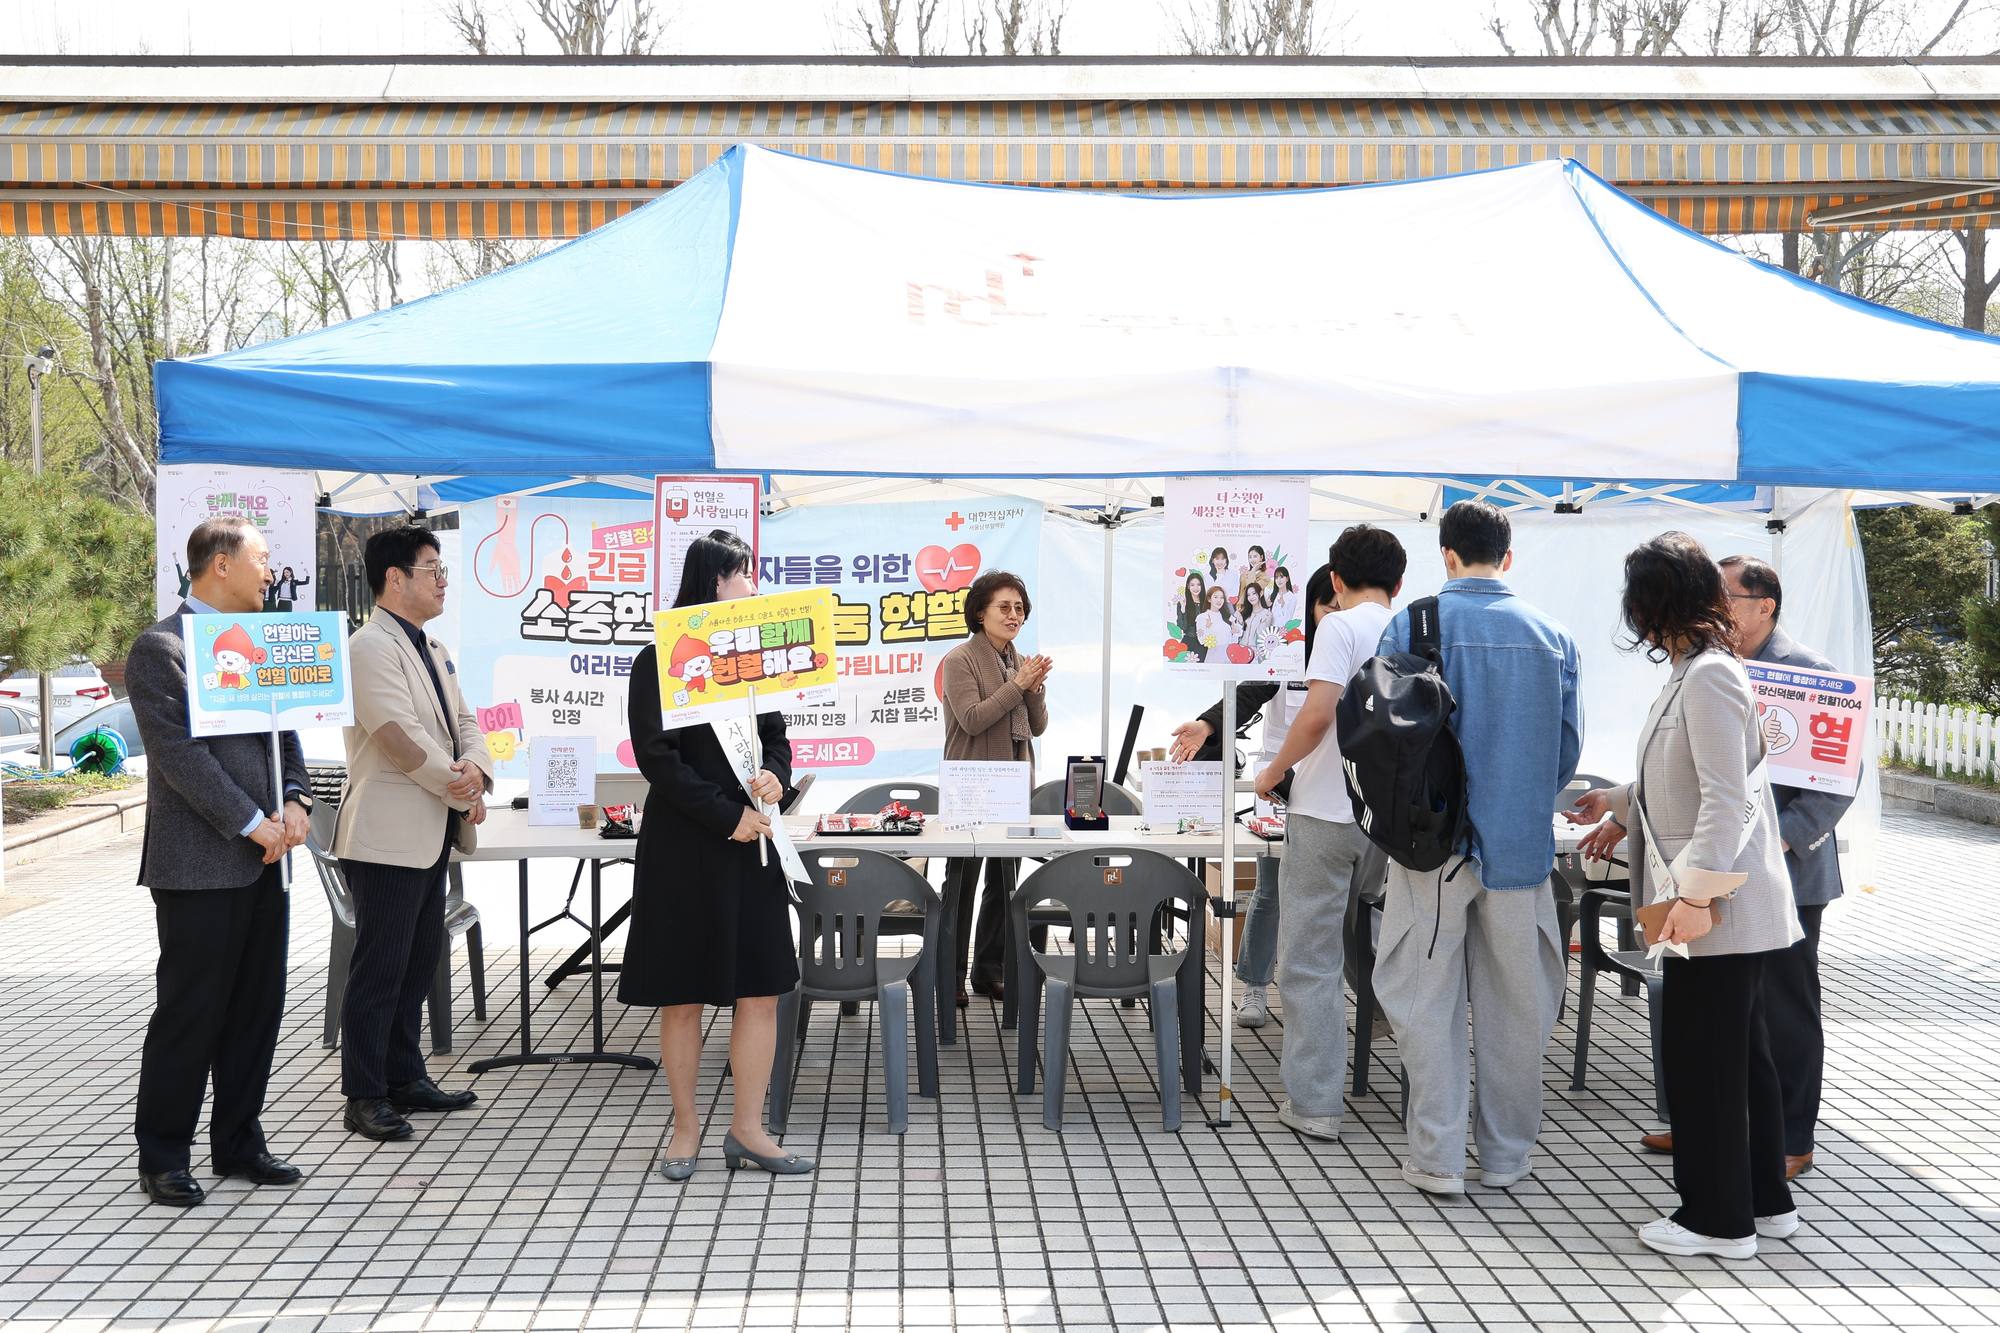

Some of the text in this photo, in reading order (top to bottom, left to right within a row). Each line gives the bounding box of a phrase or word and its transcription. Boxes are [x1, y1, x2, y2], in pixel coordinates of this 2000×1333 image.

[693, 490, 726, 504] 헌혈은
[1217, 490, 1264, 505] 더 스윗한
[693, 505, 749, 519] 사랑입니다
[968, 508, 1024, 523] 대한적십자사
[1192, 505, 1286, 520] 세상을 만드는 우리
[588, 551, 647, 582] 긴급
[759, 555, 843, 585] 자들을
[851, 553, 912, 584] 위한
[521, 586, 973, 646] 소중한 눔 헌혈
[262, 623, 321, 644] 헌혈하는
[271, 644, 316, 665] 당신은
[570, 653, 923, 677] 여러분 다립니다!
[712, 646, 816, 686] 헌혈해요
[256, 665, 333, 687] 헌혈 히어로
[1746, 667, 1843, 690] 리는 헌혈에 동참해 주세요
[530, 688, 605, 707] 봉사 4시간
[883, 687, 926, 705] 신분증
[484, 706, 515, 732] GO!
[552, 709, 581, 725] 인정
[821, 713, 846, 727] 인정
[870, 706, 938, 724] 지참 필수!
[1809, 712, 1853, 765] 혈
[796, 743, 859, 763] 주세요!
